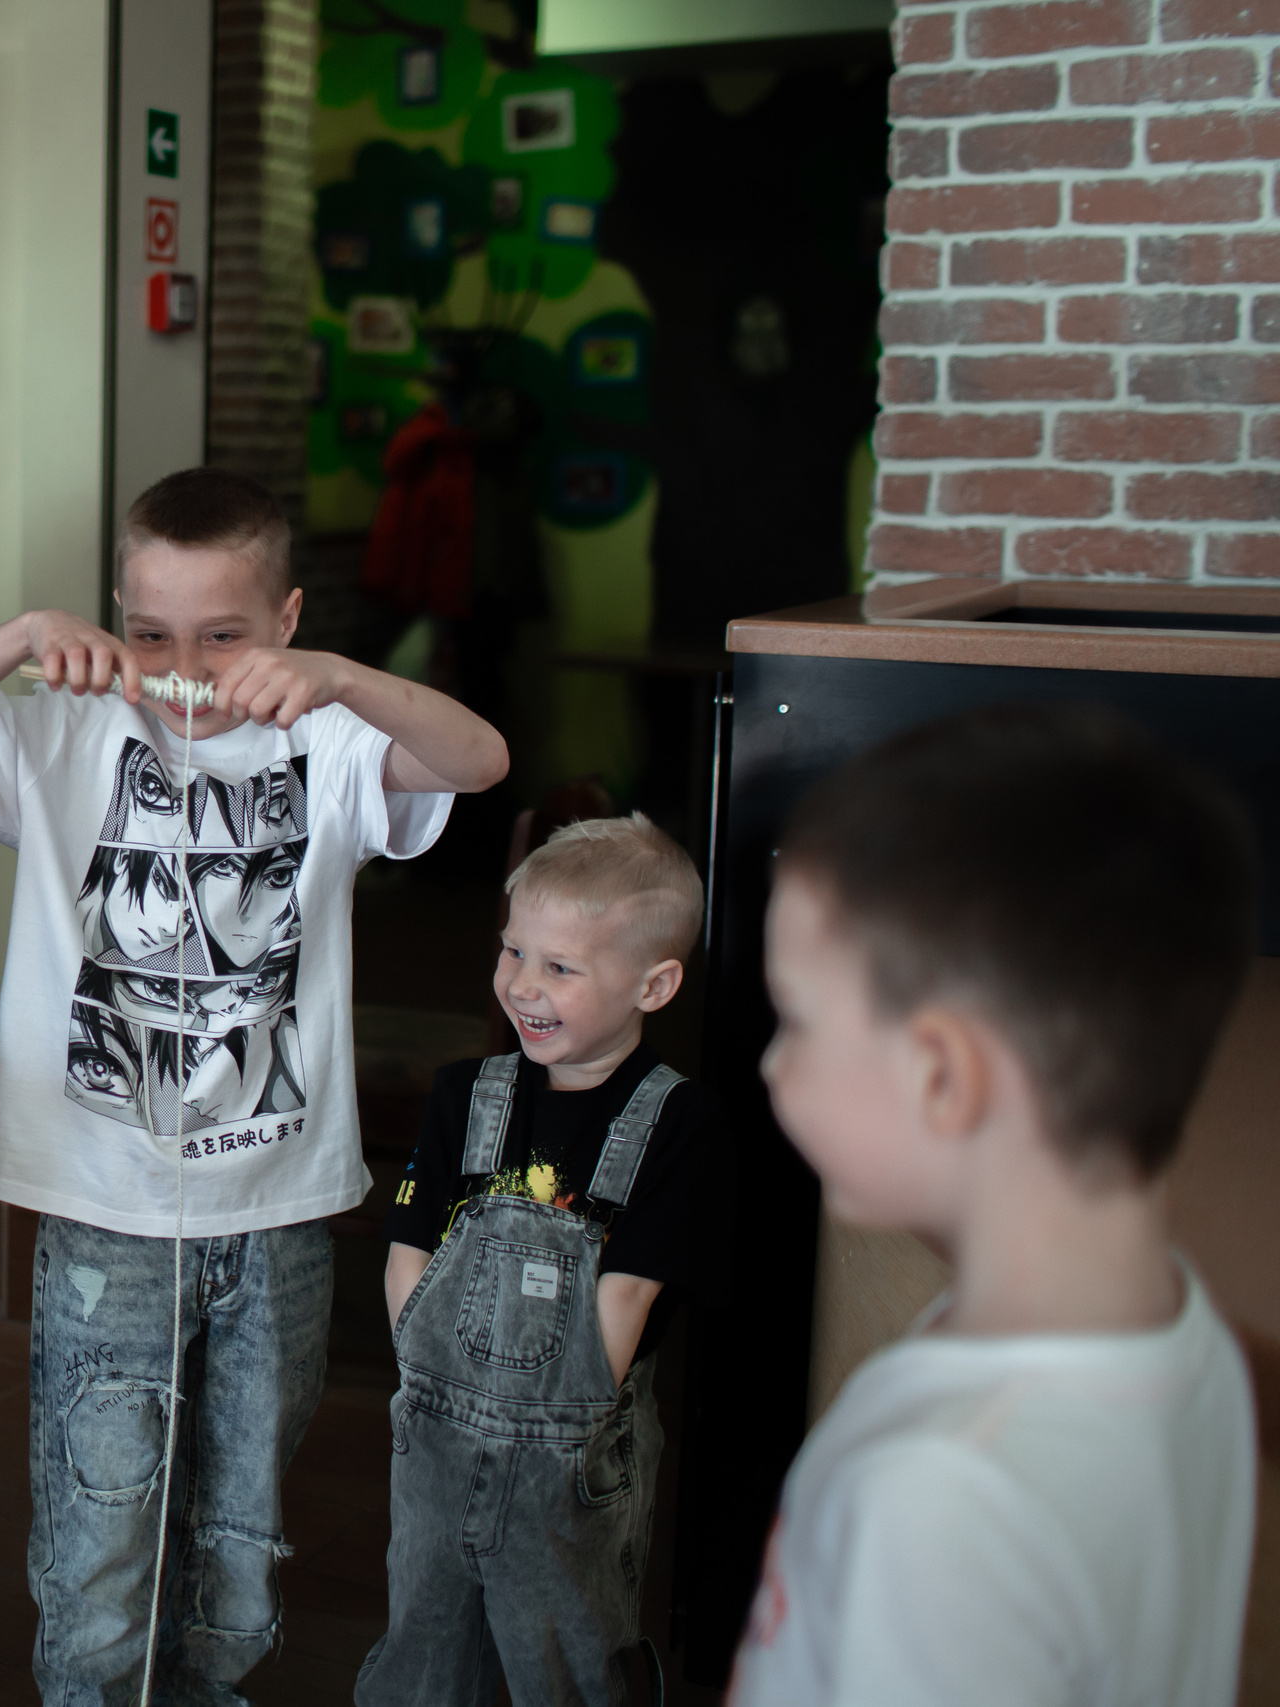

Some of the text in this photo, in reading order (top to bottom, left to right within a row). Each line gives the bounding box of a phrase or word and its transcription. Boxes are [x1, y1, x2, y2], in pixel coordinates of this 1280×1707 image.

[180, 1117, 306, 1159] 魂を反映します
[63, 1342, 115, 1381] BANG
